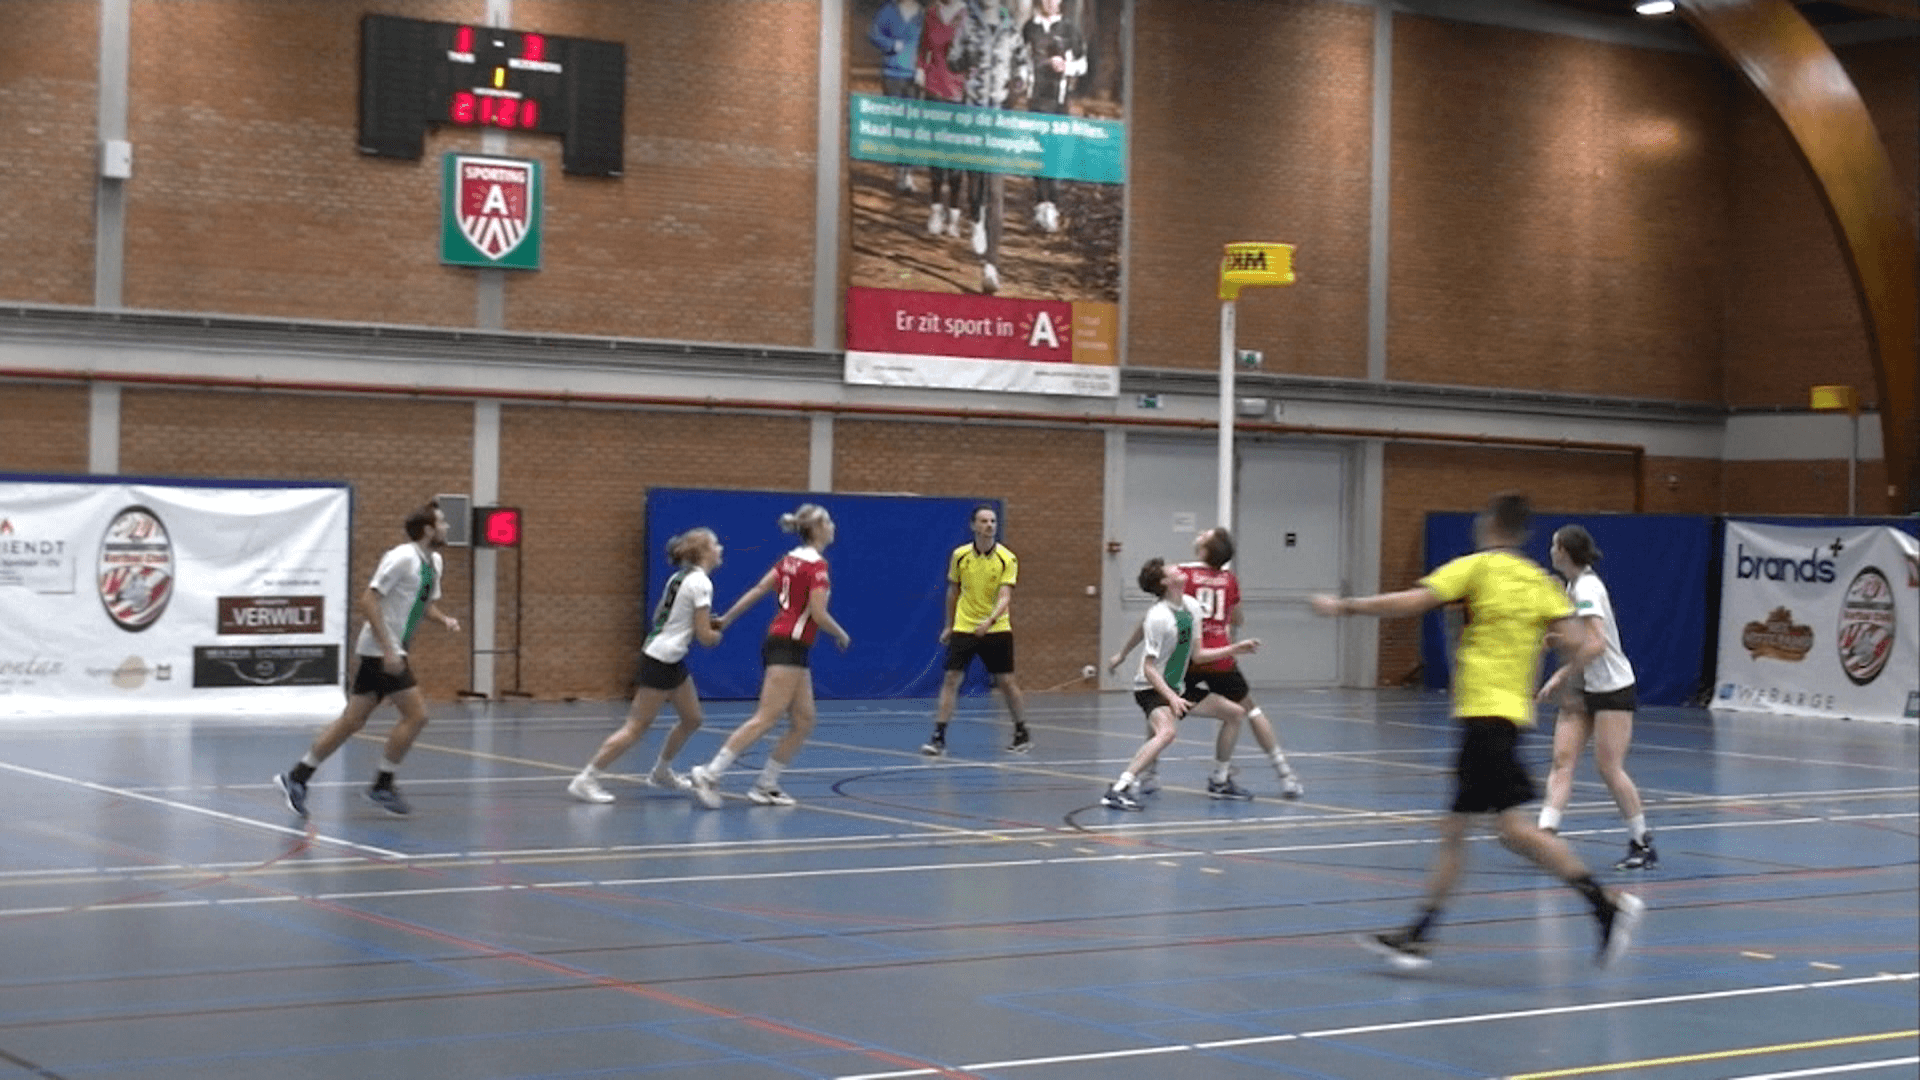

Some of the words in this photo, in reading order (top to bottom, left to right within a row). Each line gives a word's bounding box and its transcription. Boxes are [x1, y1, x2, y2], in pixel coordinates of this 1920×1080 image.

[465, 166, 526, 183] SPORTING
[481, 184, 509, 215] A
[896, 310, 917, 331] Er
[917, 312, 941, 333] zit
[943, 316, 992, 338] sport
[996, 316, 1014, 337] in
[1029, 311, 1060, 348] A
[1, 539, 66, 555] IENDT
[232, 606, 315, 627] VERWILT
